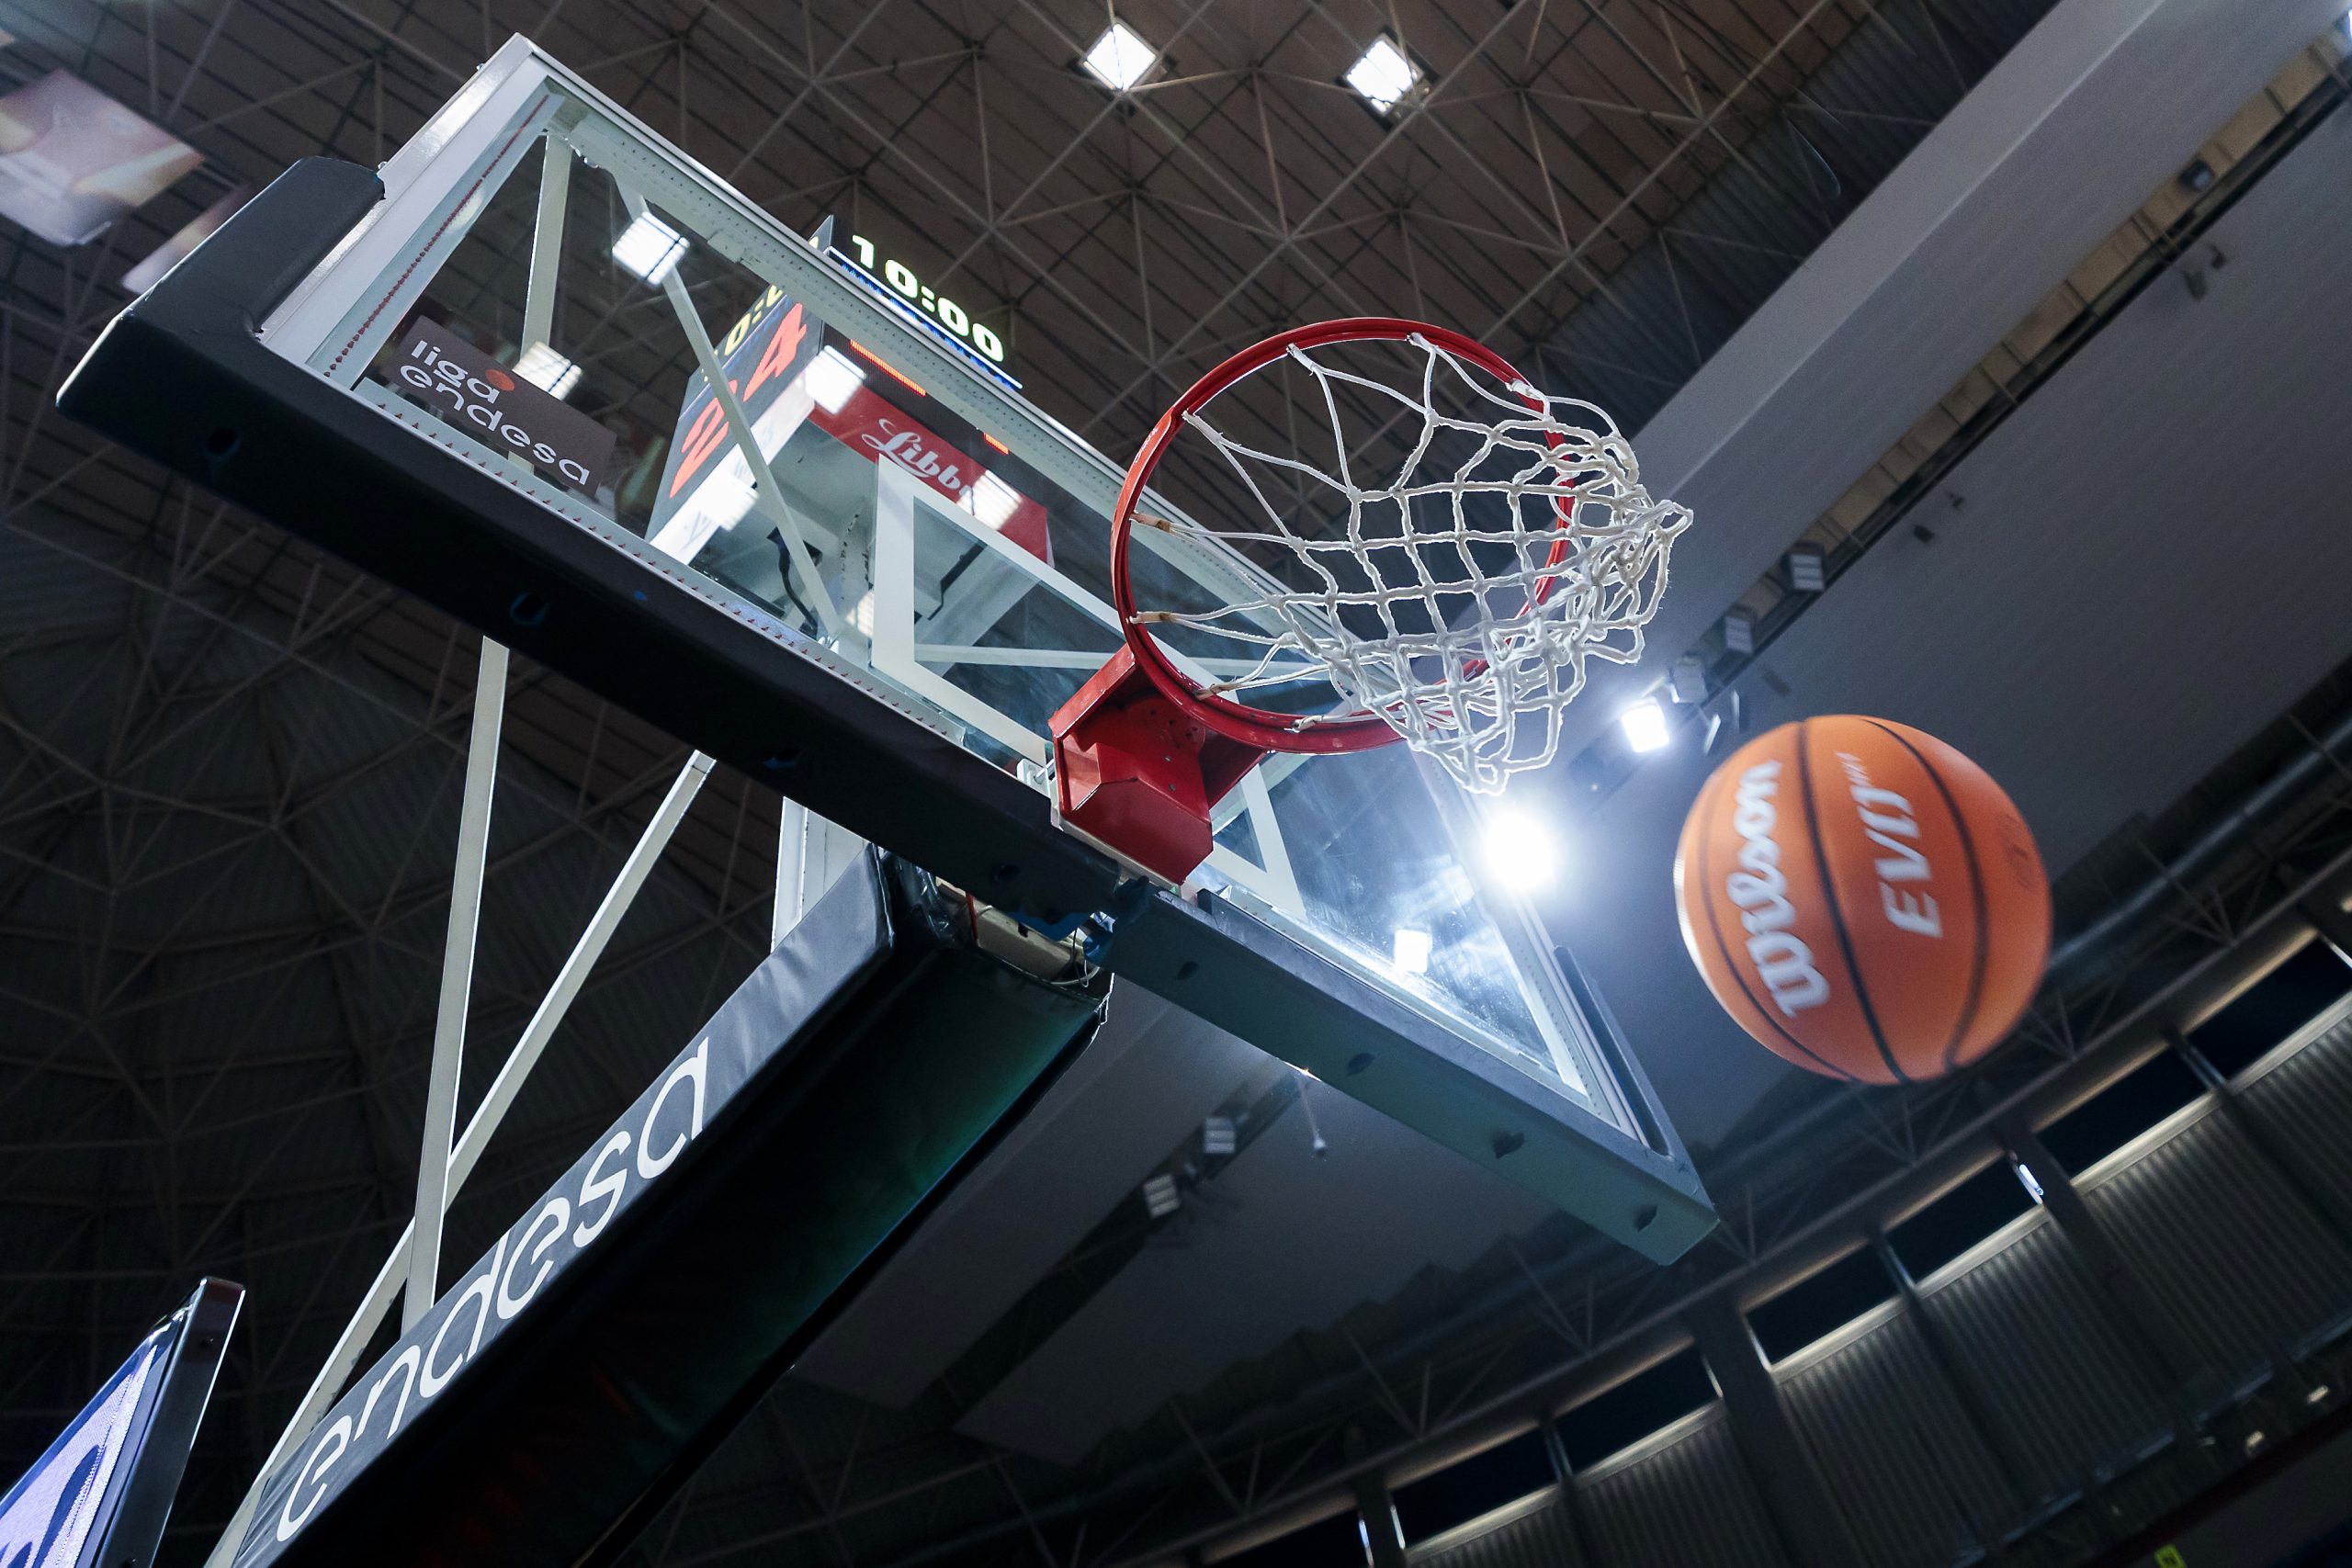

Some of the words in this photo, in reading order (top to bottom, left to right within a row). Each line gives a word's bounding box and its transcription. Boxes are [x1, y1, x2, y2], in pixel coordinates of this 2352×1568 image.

[852, 234, 1004, 362] 10:00
[400, 365, 590, 486] endesa
[411, 340, 501, 404] liga
[1726, 760, 1831, 1019] Wilson
[1849, 784, 1943, 939] EVO
[276, 1036, 709, 1542] endesa
